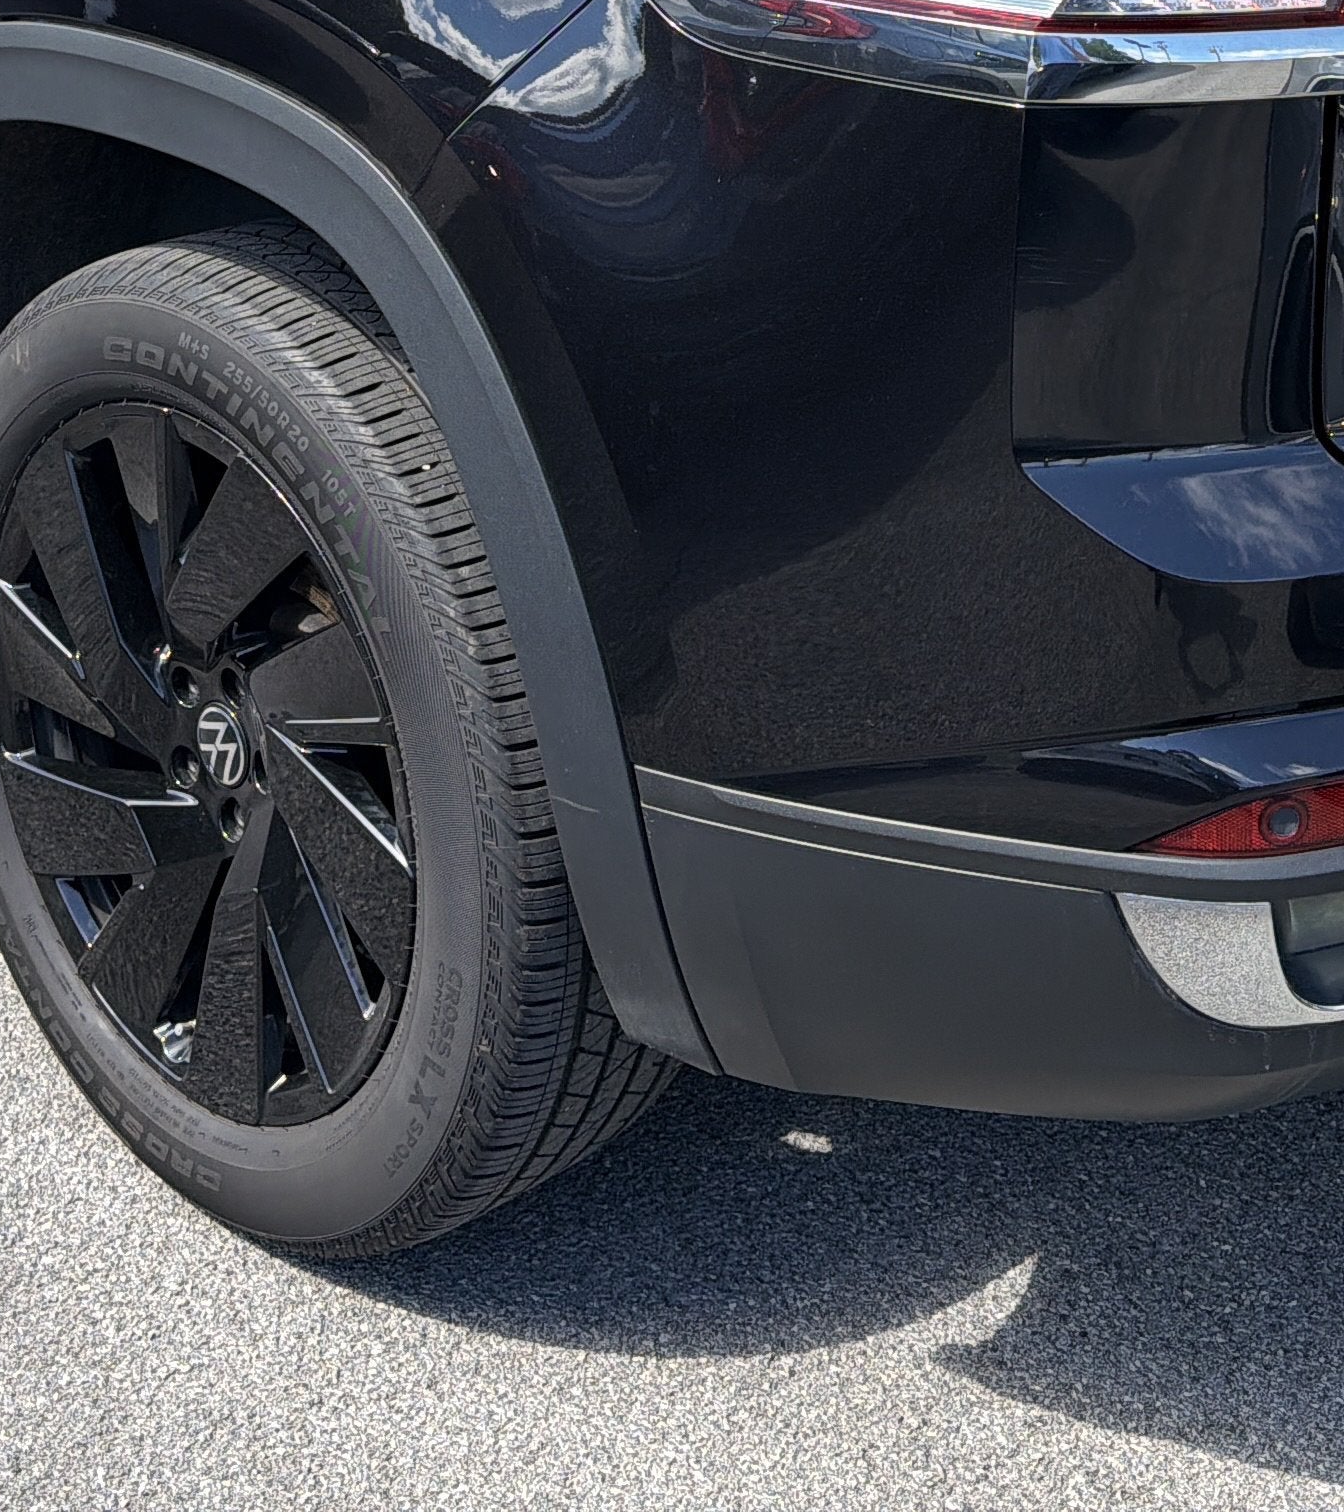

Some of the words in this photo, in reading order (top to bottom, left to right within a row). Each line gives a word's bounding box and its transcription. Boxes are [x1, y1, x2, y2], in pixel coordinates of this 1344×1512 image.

[102, 334, 392, 634] CONTINENTAL
[222, 361, 311, 454] 255/50R20
[321, 469, 358, 519] 105T
[435, 968, 463, 1059] CROSS
[383, 1117, 424, 1180] SPORT
